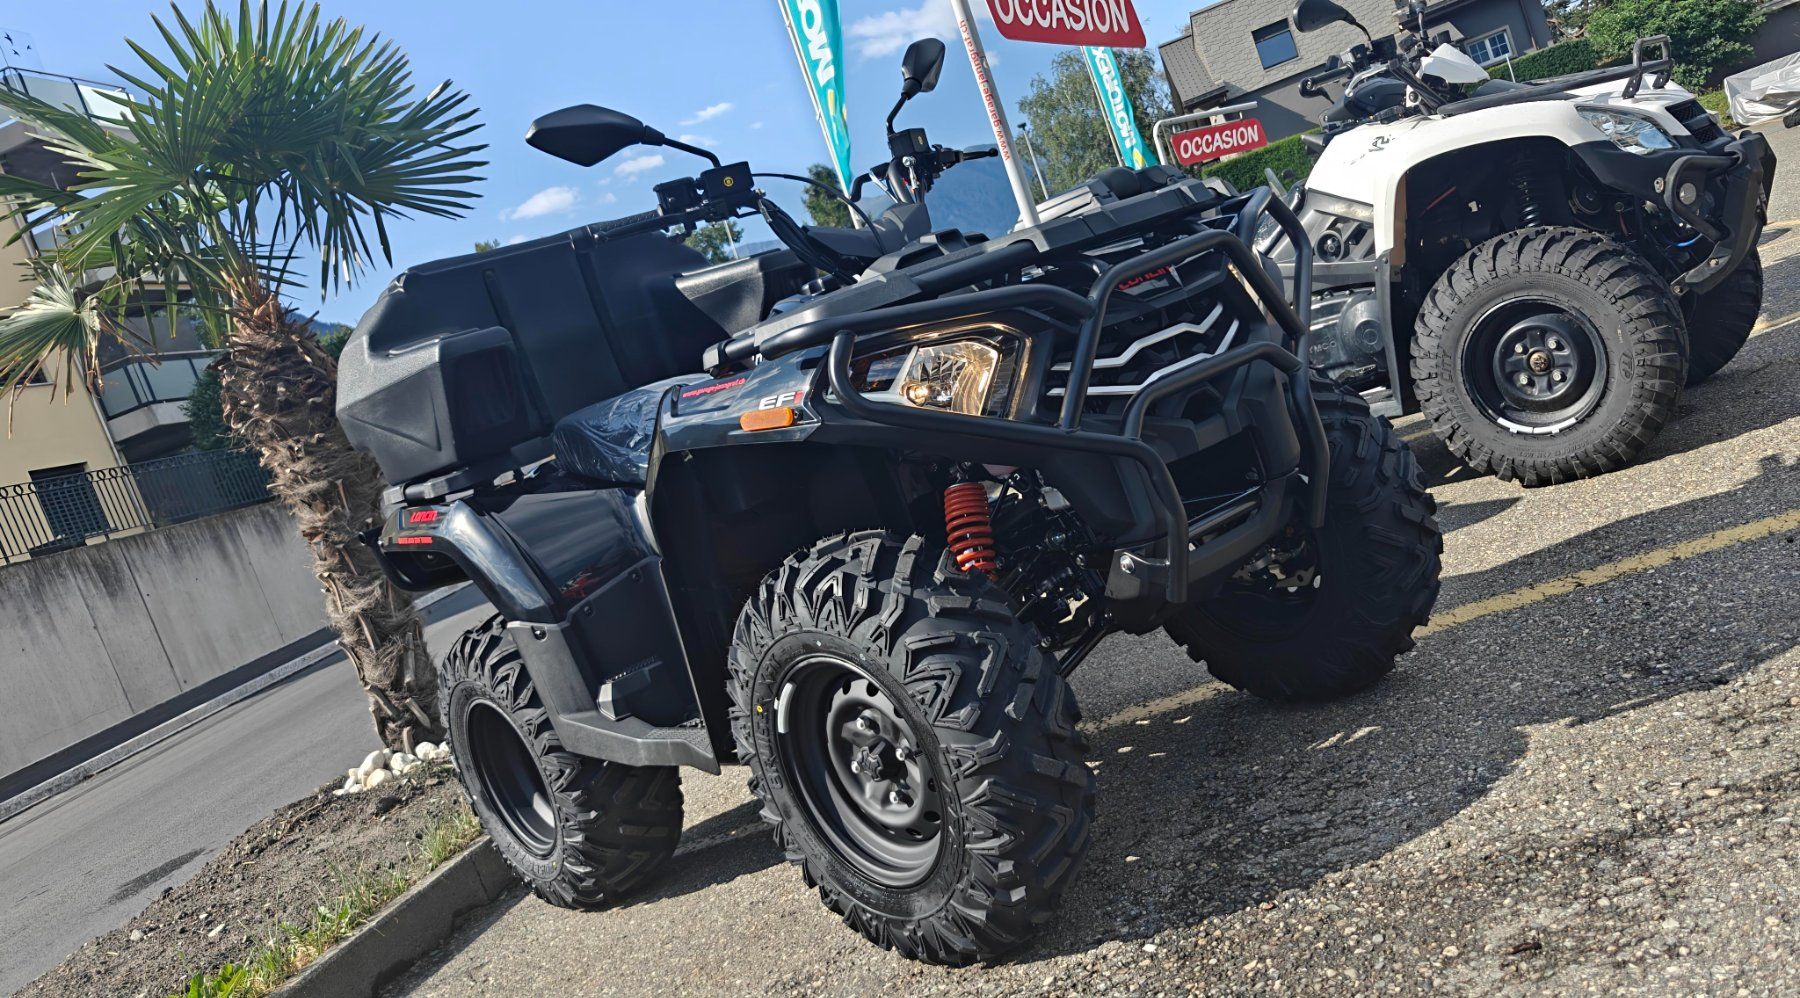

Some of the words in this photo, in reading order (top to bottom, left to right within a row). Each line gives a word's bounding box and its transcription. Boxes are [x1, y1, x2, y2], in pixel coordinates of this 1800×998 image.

[796, 0, 835, 87] MO
[995, 0, 1130, 33] OCCASION
[1091, 47, 1136, 149] MOTOREX
[1180, 124, 1259, 159] OCCASION
